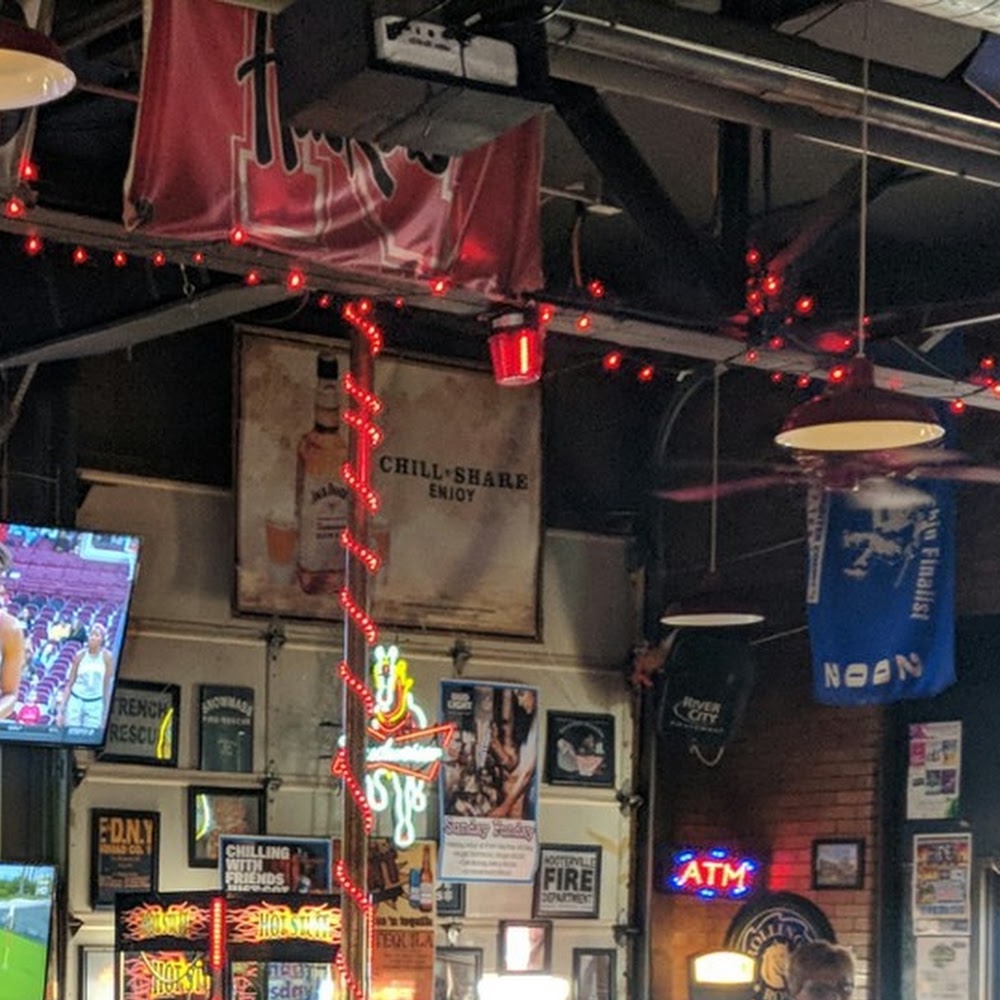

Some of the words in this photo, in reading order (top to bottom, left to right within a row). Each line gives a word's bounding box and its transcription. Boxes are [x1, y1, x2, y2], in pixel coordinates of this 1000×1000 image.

[379, 455, 441, 480] CHILL
[454, 466, 529, 491] SHARE
[429, 483, 475, 503] ENJOY
[682, 696, 722, 714] RIVER
[688, 710, 718, 724] CITY
[110, 724, 160, 745] RESCU
[443, 816, 492, 840] Sunday
[225, 844, 290, 858] CHILLING
[225, 859, 263, 872] WITH
[680, 859, 748, 889] ATM
[225, 872, 285, 884] FRIENDS
[544, 867, 593, 892] FIRE
[259, 911, 289, 938] HOT
[152, 960, 182, 993] HOT
